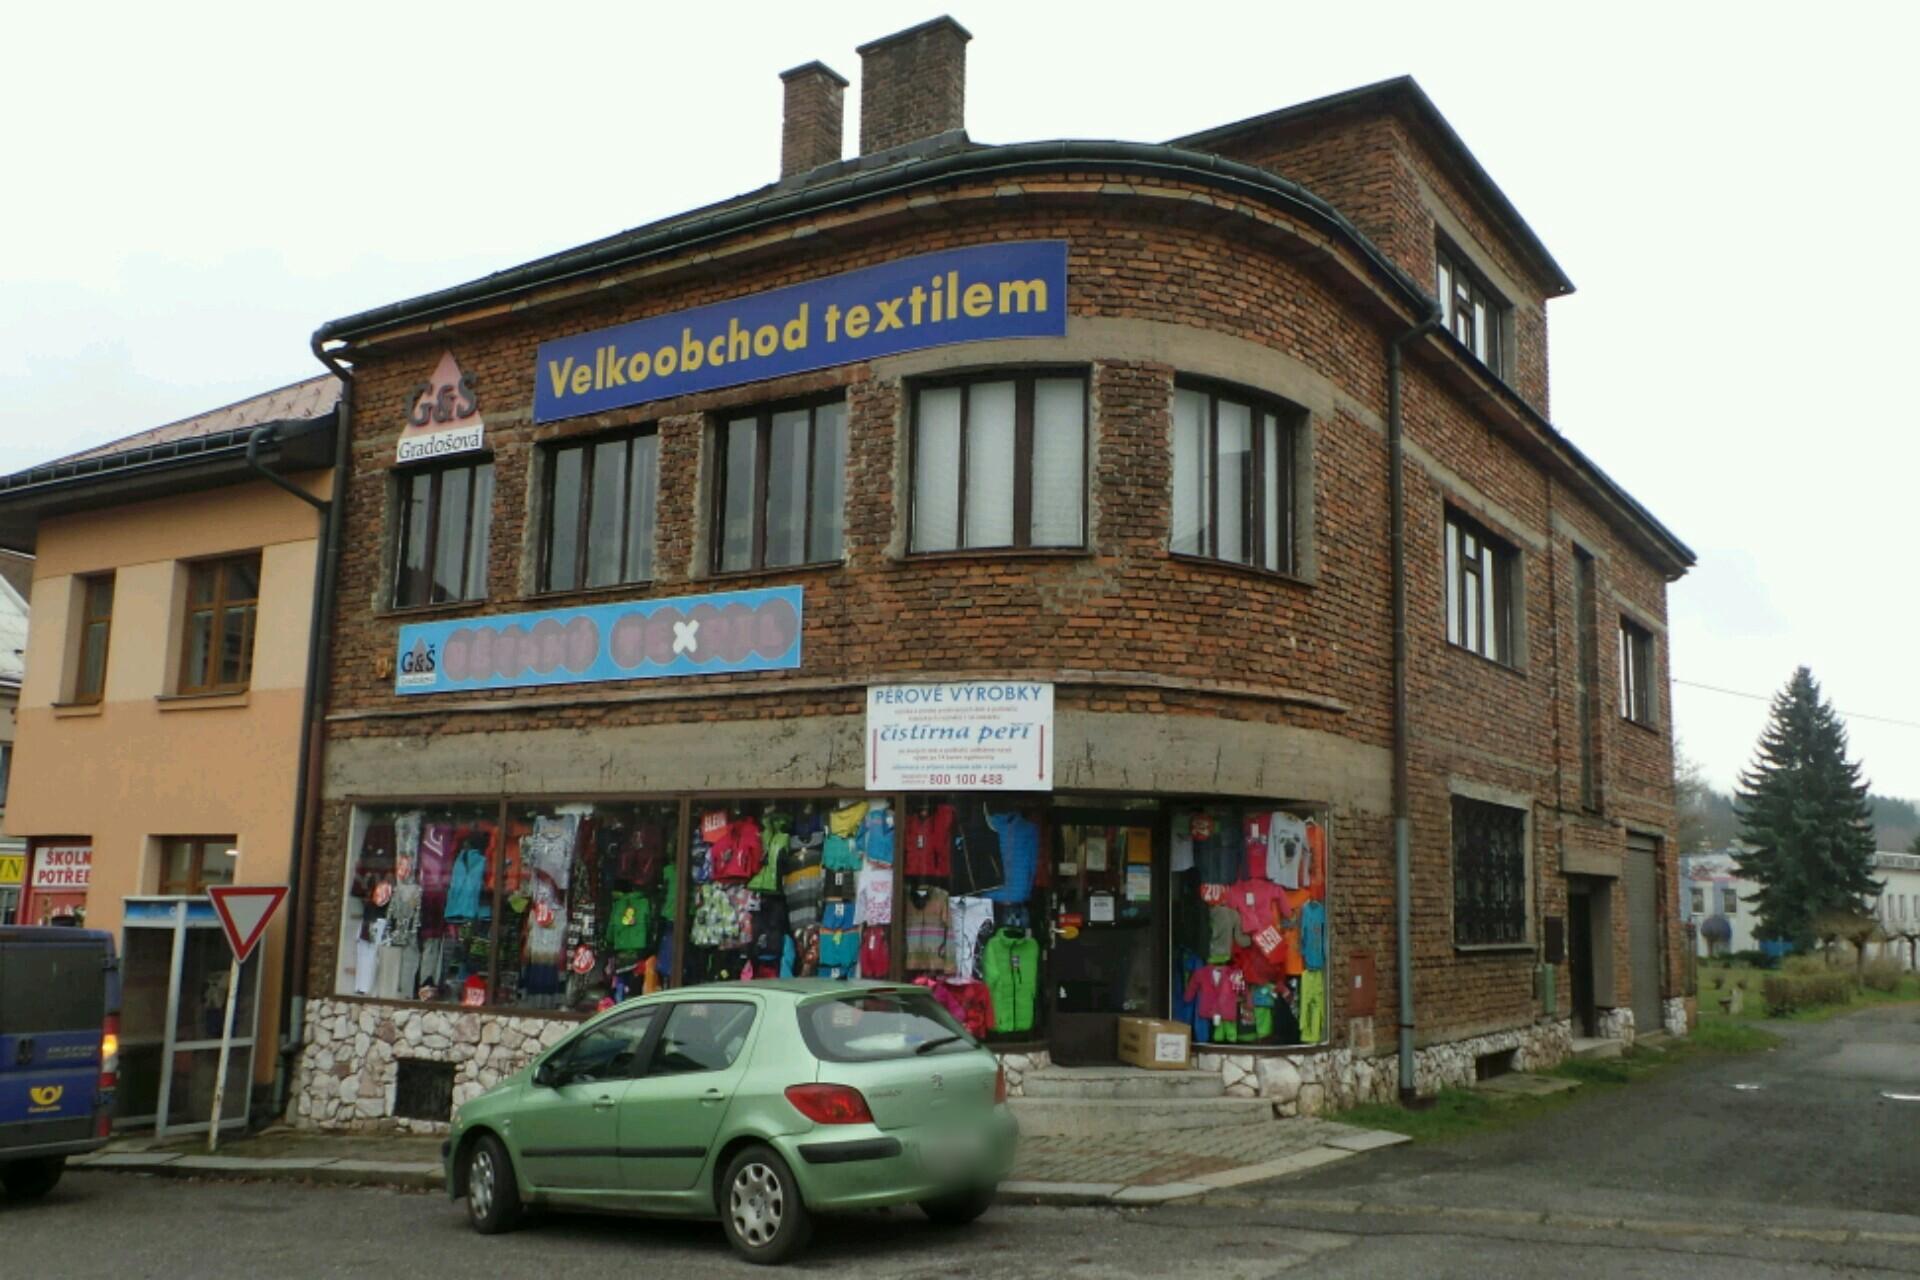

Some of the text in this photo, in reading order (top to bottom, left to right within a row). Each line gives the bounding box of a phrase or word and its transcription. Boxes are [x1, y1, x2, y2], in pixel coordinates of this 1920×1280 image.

[548, 271, 1049, 399] Velkoobchod textilem
[399, 430, 480, 459] Gradošová
[401, 643, 436, 673] G&Š
[951, 682, 1042, 702] VÝROBKY
[929, 774, 951, 785] 800
[956, 774, 976, 785] 100
[0, 859, 24, 879] N
